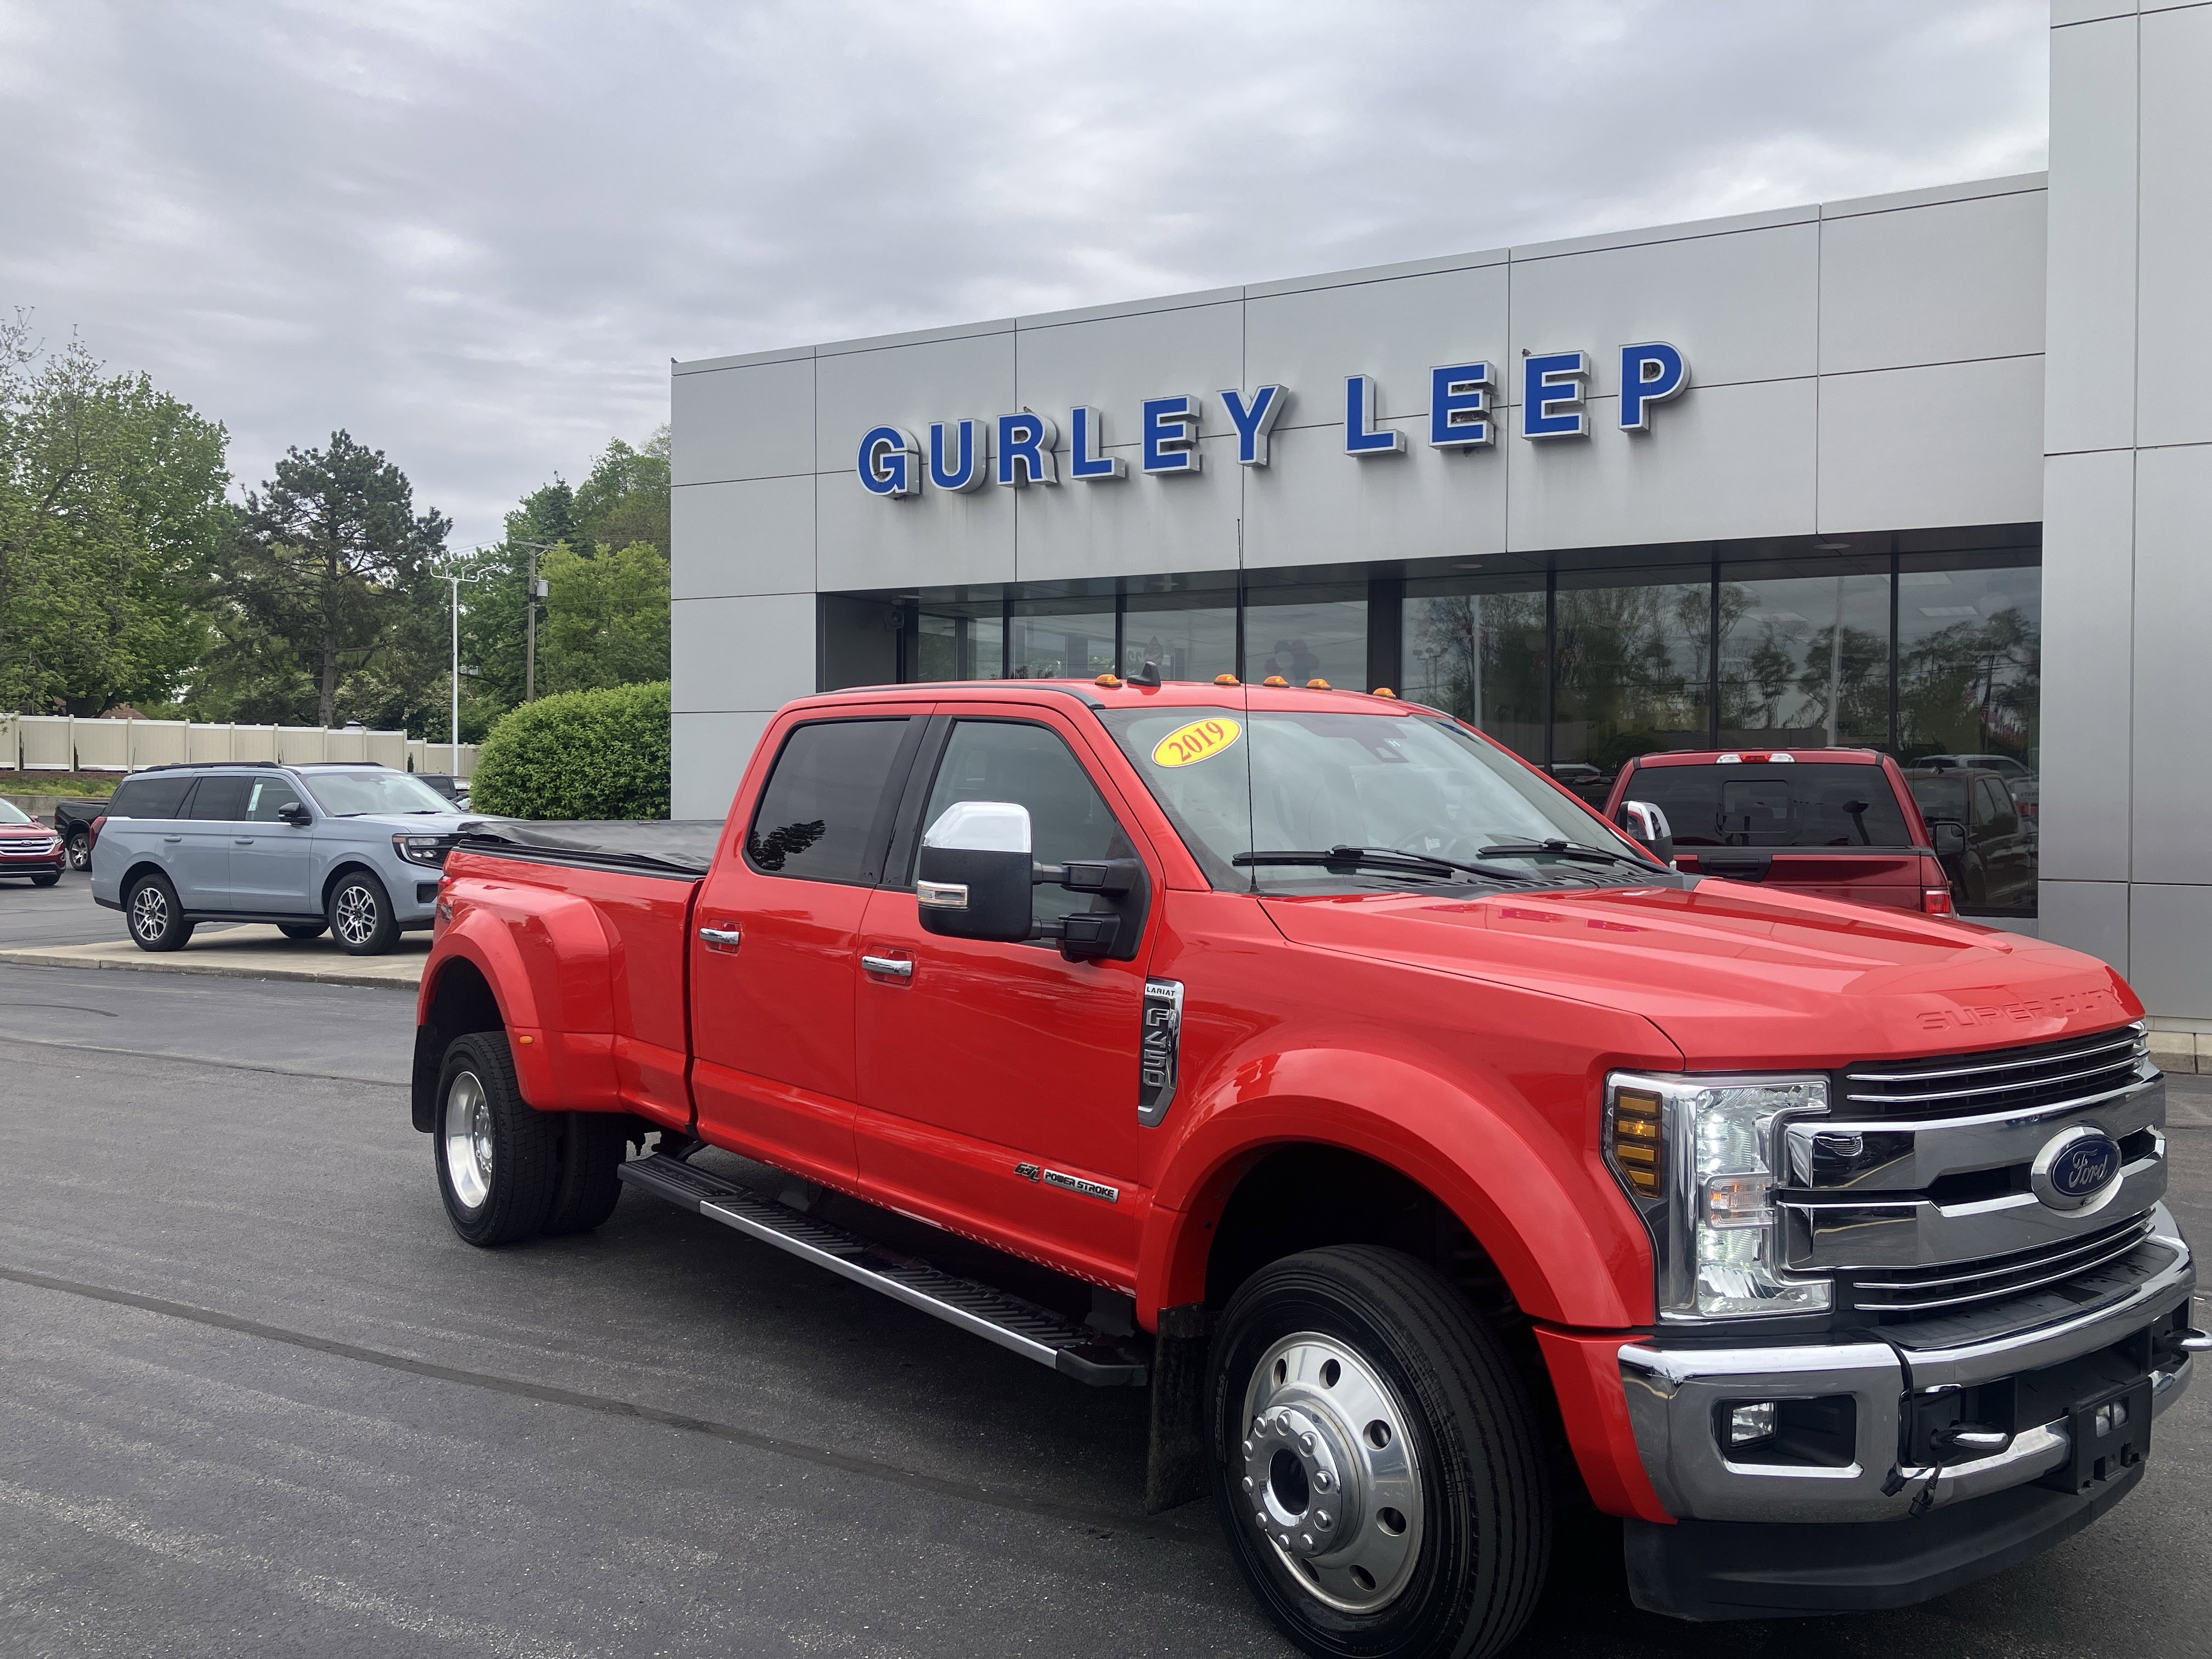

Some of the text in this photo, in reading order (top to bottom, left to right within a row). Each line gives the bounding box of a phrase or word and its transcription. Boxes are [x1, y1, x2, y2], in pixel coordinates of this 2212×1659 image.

[857, 341, 1690, 498] GURLEY LEEP
[1169, 721, 1224, 762] 2019
[1146, 986, 1176, 997] LARIAT
[1045, 1171, 1076, 1187] POWER
[1076, 1181, 1115, 1198] STROKE
[2068, 1148, 2108, 1188] Ford
